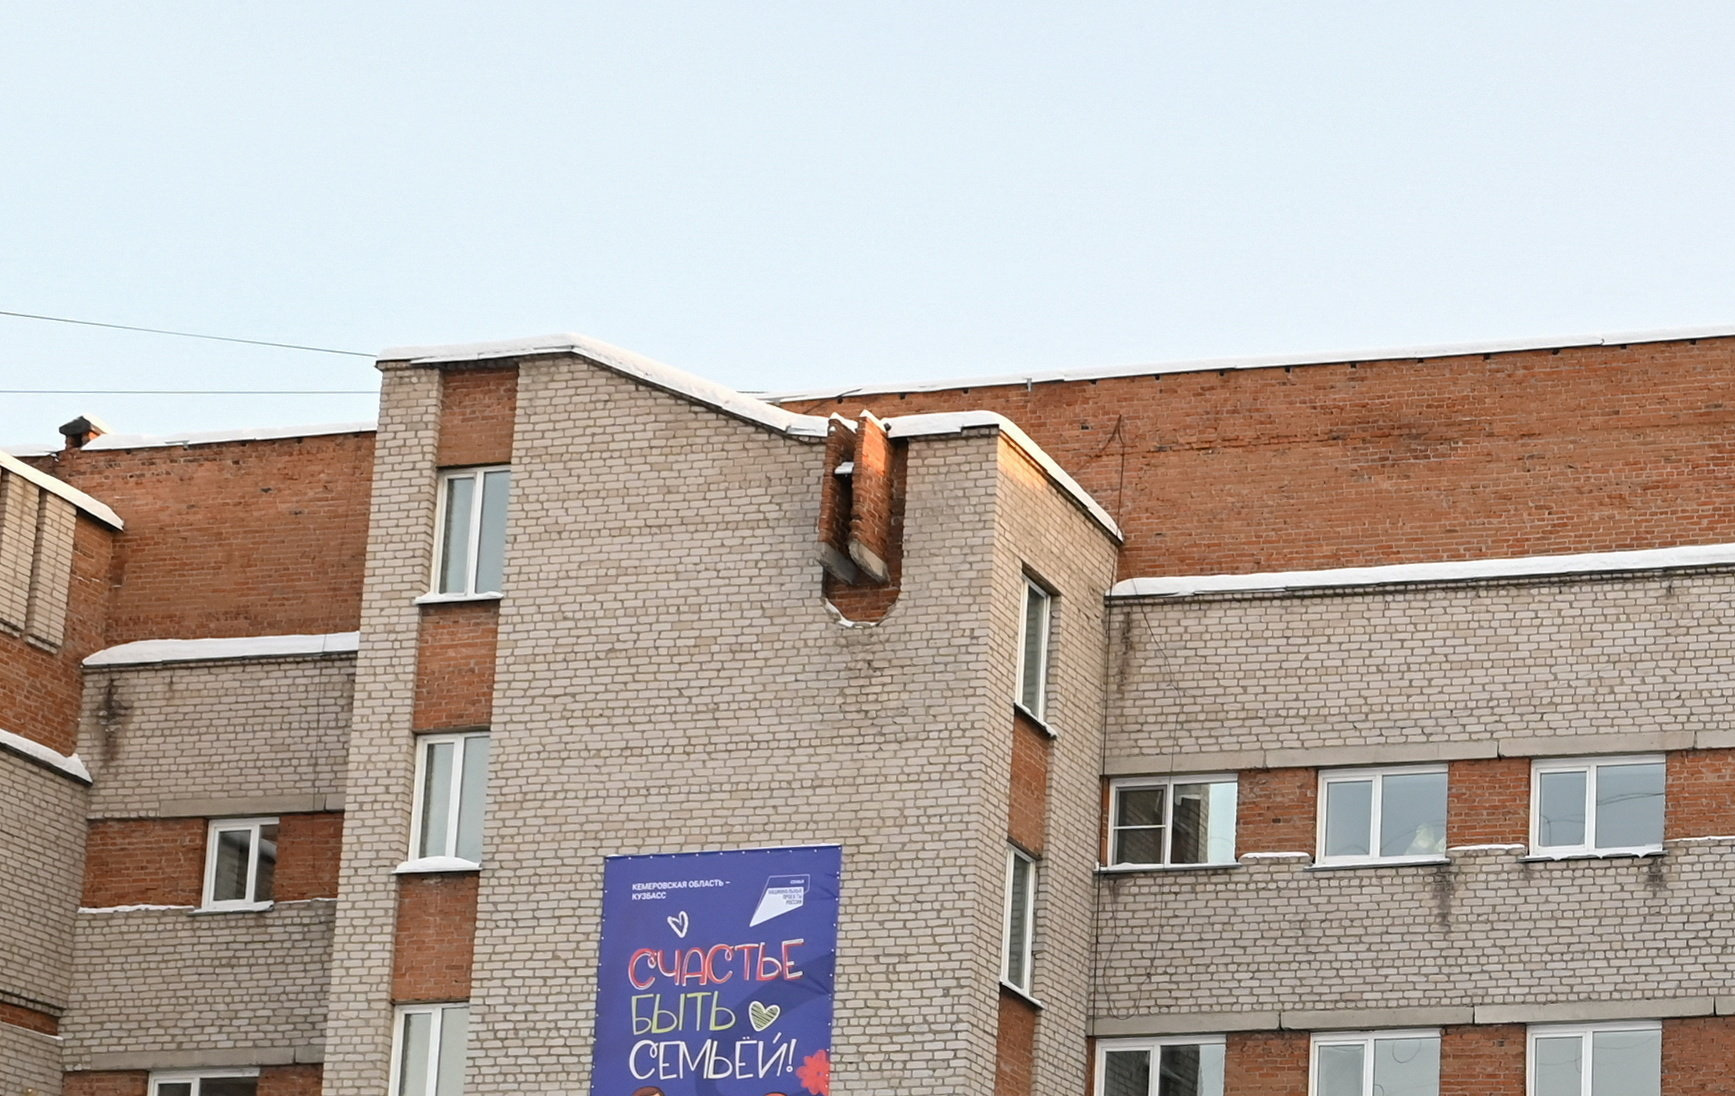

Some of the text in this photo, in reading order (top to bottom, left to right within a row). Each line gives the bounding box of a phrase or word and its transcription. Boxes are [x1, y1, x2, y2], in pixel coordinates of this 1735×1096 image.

[631, 881, 687, 891] КЕМЕРОВСКАЯ
[688, 879, 724, 888] ОБЛАСТЬ
[631, 891, 667, 900] КУЗБАСС
[628, 938, 804, 990] СЧАСТЬЕ
[631, 991, 736, 1035] БЫТЬ
